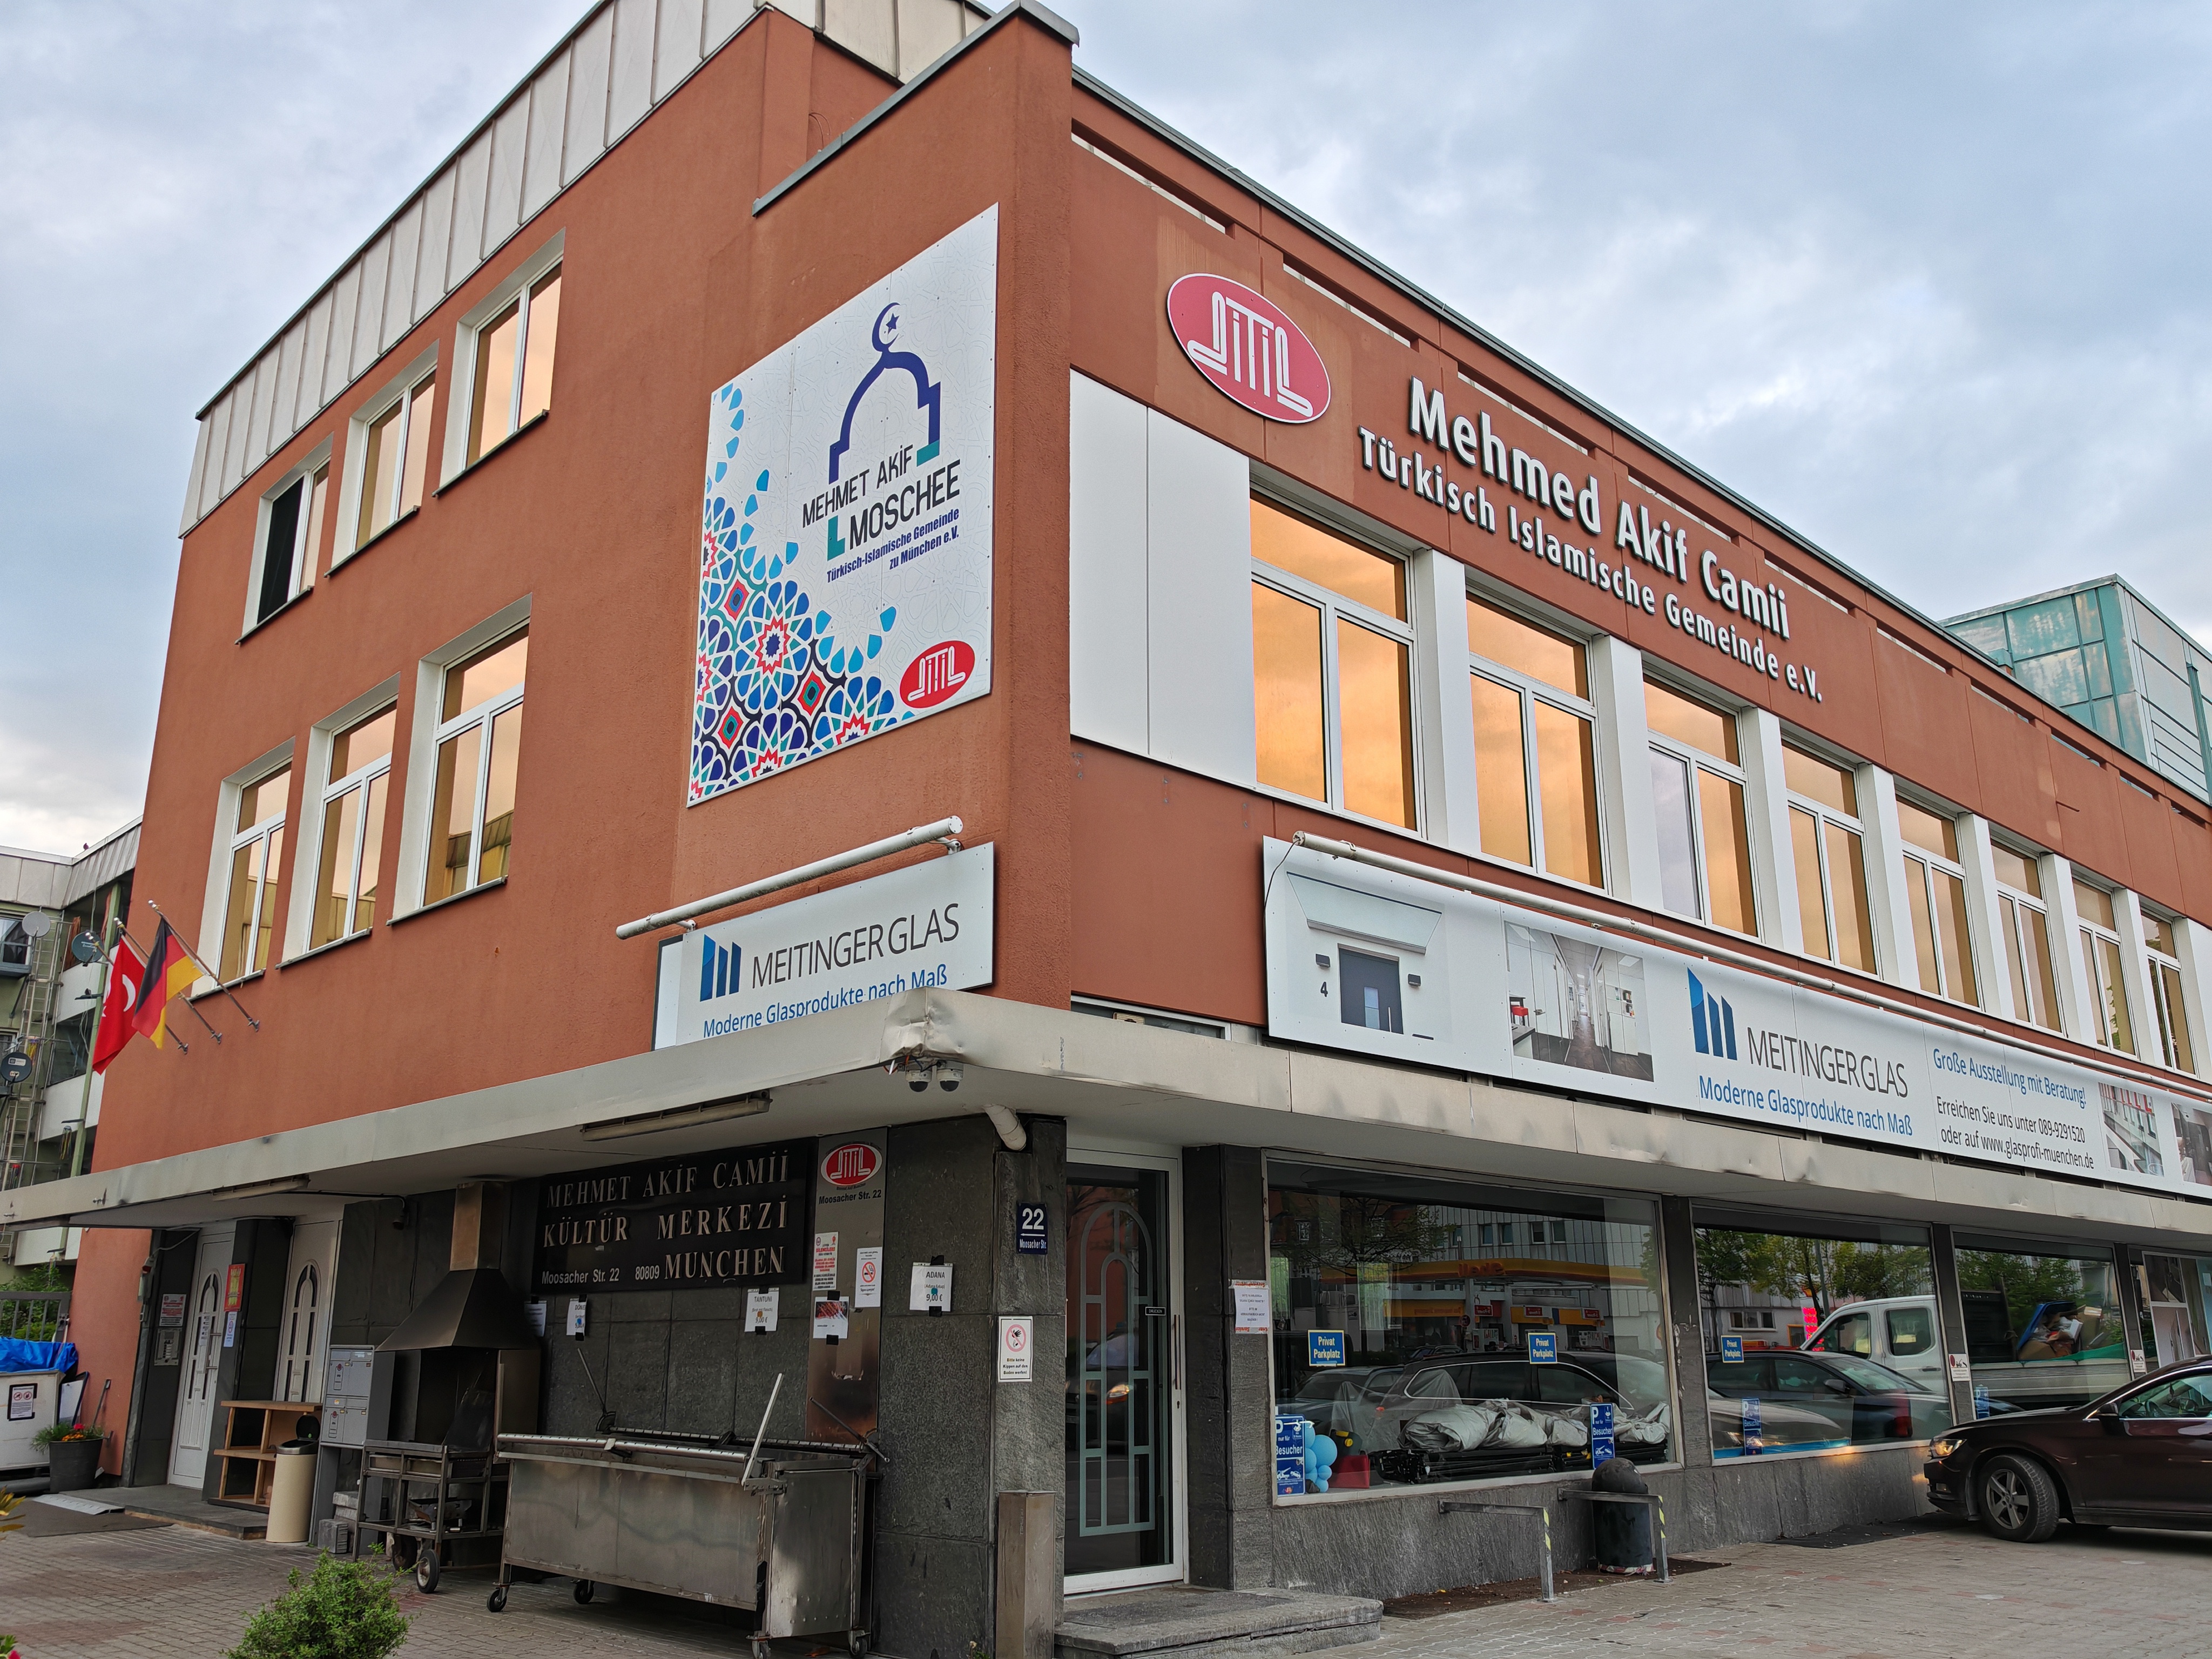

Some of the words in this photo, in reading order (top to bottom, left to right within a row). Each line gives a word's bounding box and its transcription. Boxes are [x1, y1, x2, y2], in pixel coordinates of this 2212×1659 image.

[802, 469, 869, 528] MEHMET
[850, 459, 961, 550] MOSCHEE
[1410, 375, 1601, 535] Mehmed
[1616, 499, 1688, 583] Akif
[1701, 550, 1790, 640] Camii
[827, 532, 912, 583] Türkisch-Islamische
[914, 508, 959, 540] Gemeinde
[889, 556, 899, 570] zu
[901, 535, 942, 565] München
[943, 525, 959, 543] e.V.
[1358, 424, 1497, 533] Türkisch
[1508, 504, 1655, 614] Islamische
[1664, 593, 1779, 678] Gemeinde
[1784, 663, 1822, 703] e.V.
[752, 903, 960, 988] MEITINGERGLAS
[704, 1011, 762, 1038] Moderne
[766, 987, 864, 1023] Glasprodukte
[868, 974, 906, 999] nach
[912, 963, 947, 988] Maß
[1320, 981, 1328, 997] 4
[1748, 1027, 1908, 1098] MEITINGERGLAS
[1933, 1048, 1967, 1075] Große
[1970, 1057, 2026, 1095] Ausstellung
[2027, 1074, 2044, 1094] mit
[2044, 1077, 2086, 1109] Beratung!
[1700, 1076, 1764, 1109] Moderne
[1768, 1089, 1853, 1125] Glasprodukte
[1857, 1109, 1885, 1131] nach
[1887, 1112, 1913, 1136] Maß
[1937, 1096, 1980, 1122] Erreichen
[1983, 1106, 1995, 1124] Sie
[1998, 1113, 2013, 1128] uns
[2015, 1116, 2036, 1133] unter
[2039, 1118, 2085, 1143] 089-9291520
[1941, 1125, 1961, 1145] oder
[1965, 1130, 1979, 1148] auf
[1981, 1135, 2094, 1169] www.glasprofi-muenchen.de
[547, 1176, 630, 1208] MEHMET
[819, 1192, 857, 1204] Moosacher
[859, 1191, 871, 1199] Str.
[873, 1189, 881, 1198] 22
[543, 1216, 628, 1247] KÜLTÜR
[658, 1195, 787, 1240] MERKEZİ
[1022, 1208, 1044, 1230] 22
[1020, 1239, 1040, 1249] Moosacher
[542, 1270, 589, 1284] Moosacher
[593, 1269, 605, 1283] Str.
[609, 1267, 619, 1282] 22
[635, 1265, 660, 1280] 80809
[926, 1294, 938, 1303] 9,00
[1314, 1348, 1340, 1360] Parkplatz
[1318, 1336, 1335, 1346] Privat
[1533, 1349, 1554, 1359] Parkplatz
[1536, 1338, 1549, 1346] Privat
[1591, 1406, 1599, 1424] P
[1743, 1401, 1749, 1417] P
[1593, 1427, 1612, 1435] Besucher
[1276, 1444, 1303, 1455] Besucher
